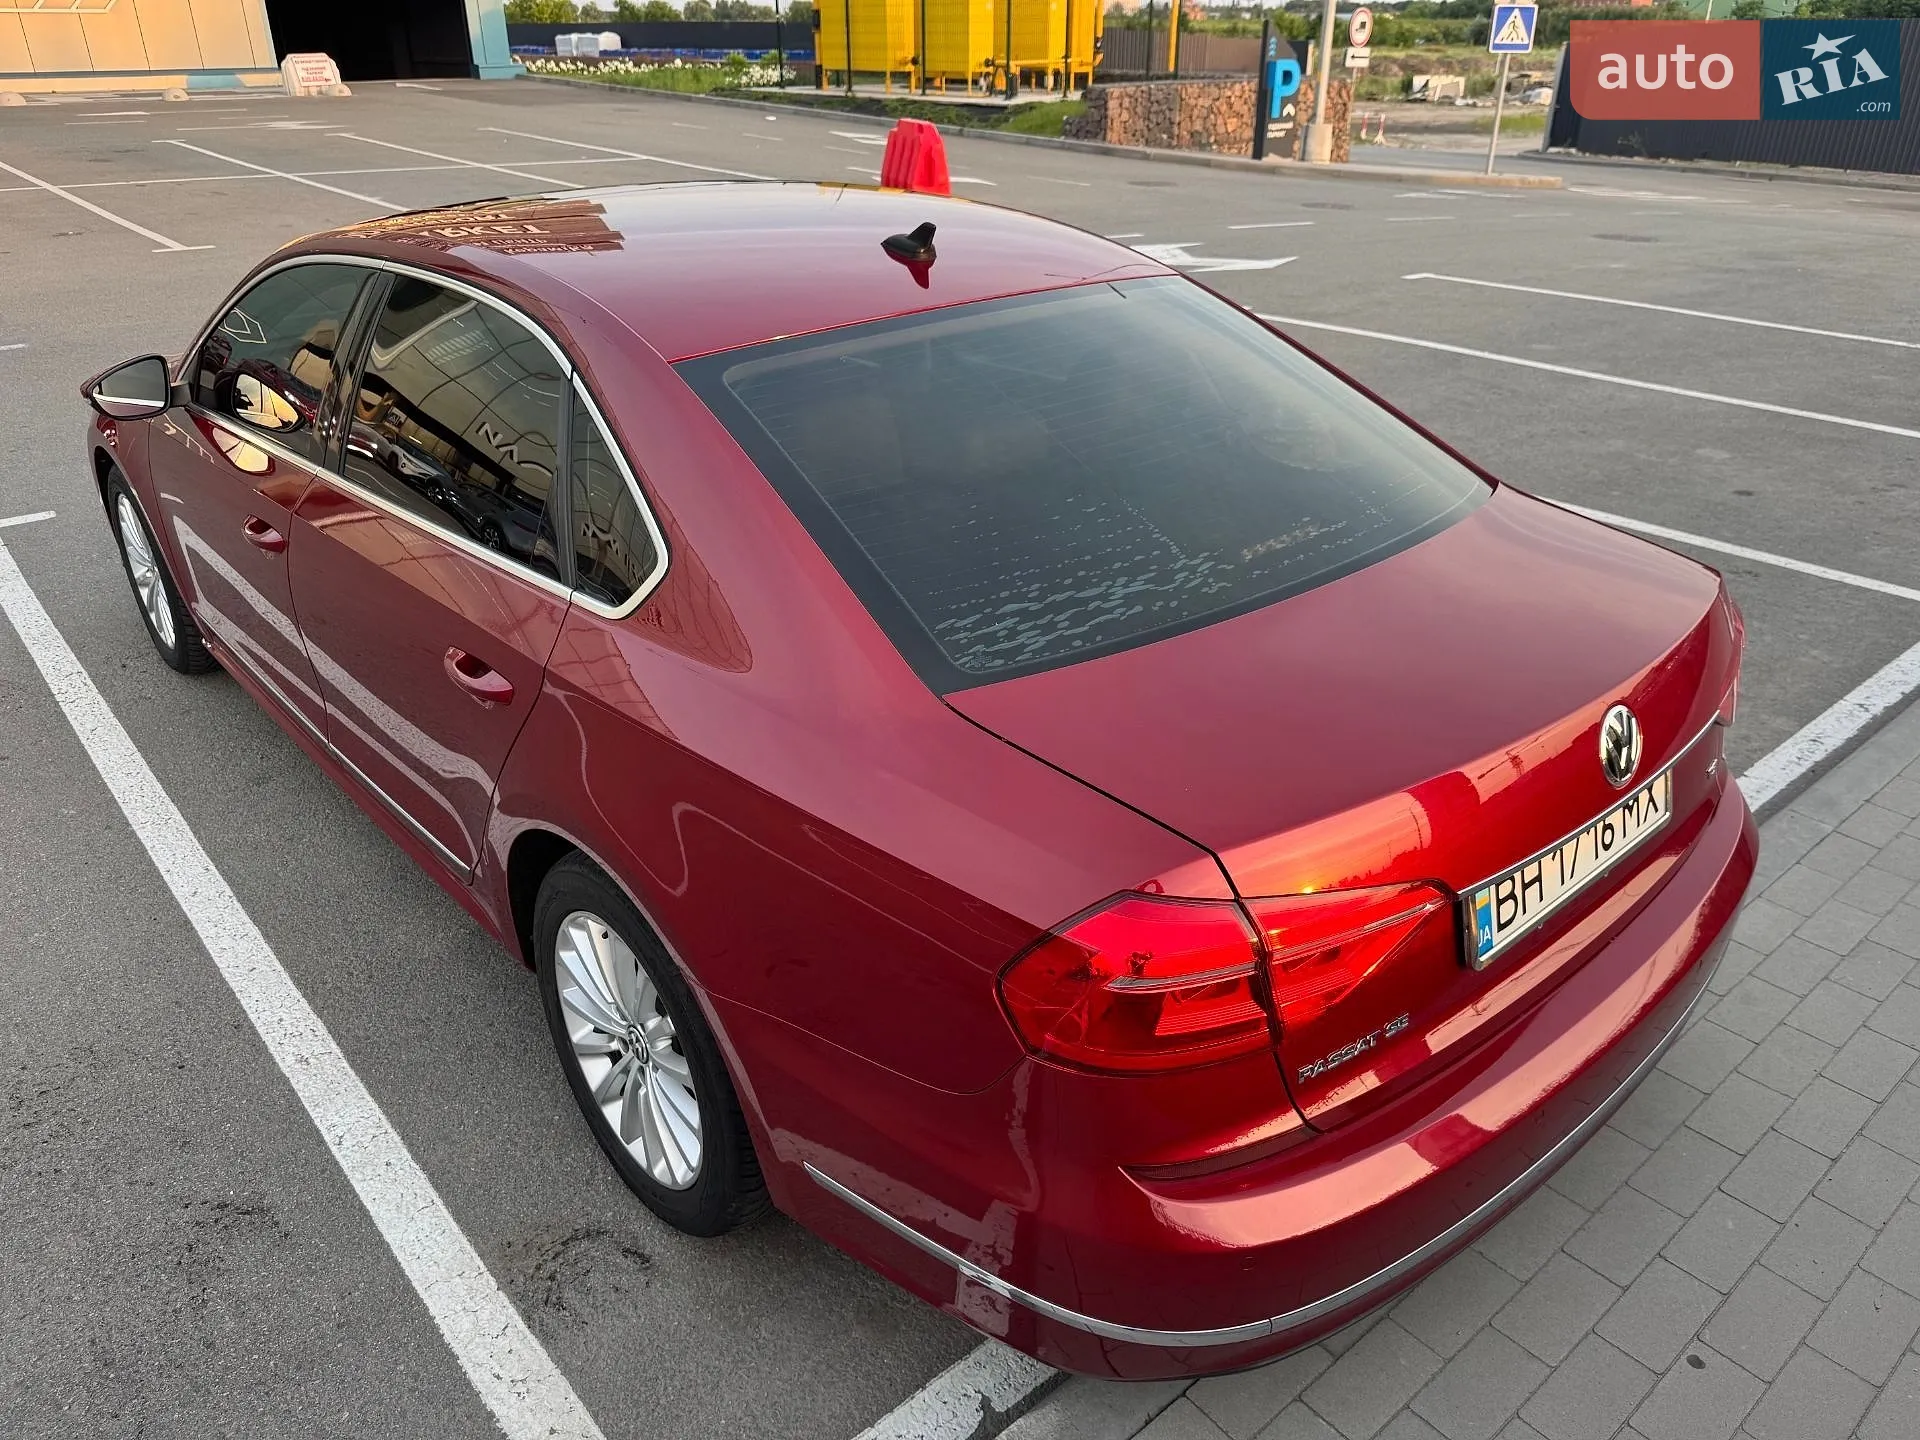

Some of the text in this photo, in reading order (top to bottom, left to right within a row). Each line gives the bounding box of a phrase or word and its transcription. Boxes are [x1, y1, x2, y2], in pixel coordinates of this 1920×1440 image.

[1270, 58, 1302, 119] P
[1495, 859, 1544, 933] BH
[1622, 783, 1659, 839] MX
[1297, 1013, 1409, 1084] PASSAT SE
